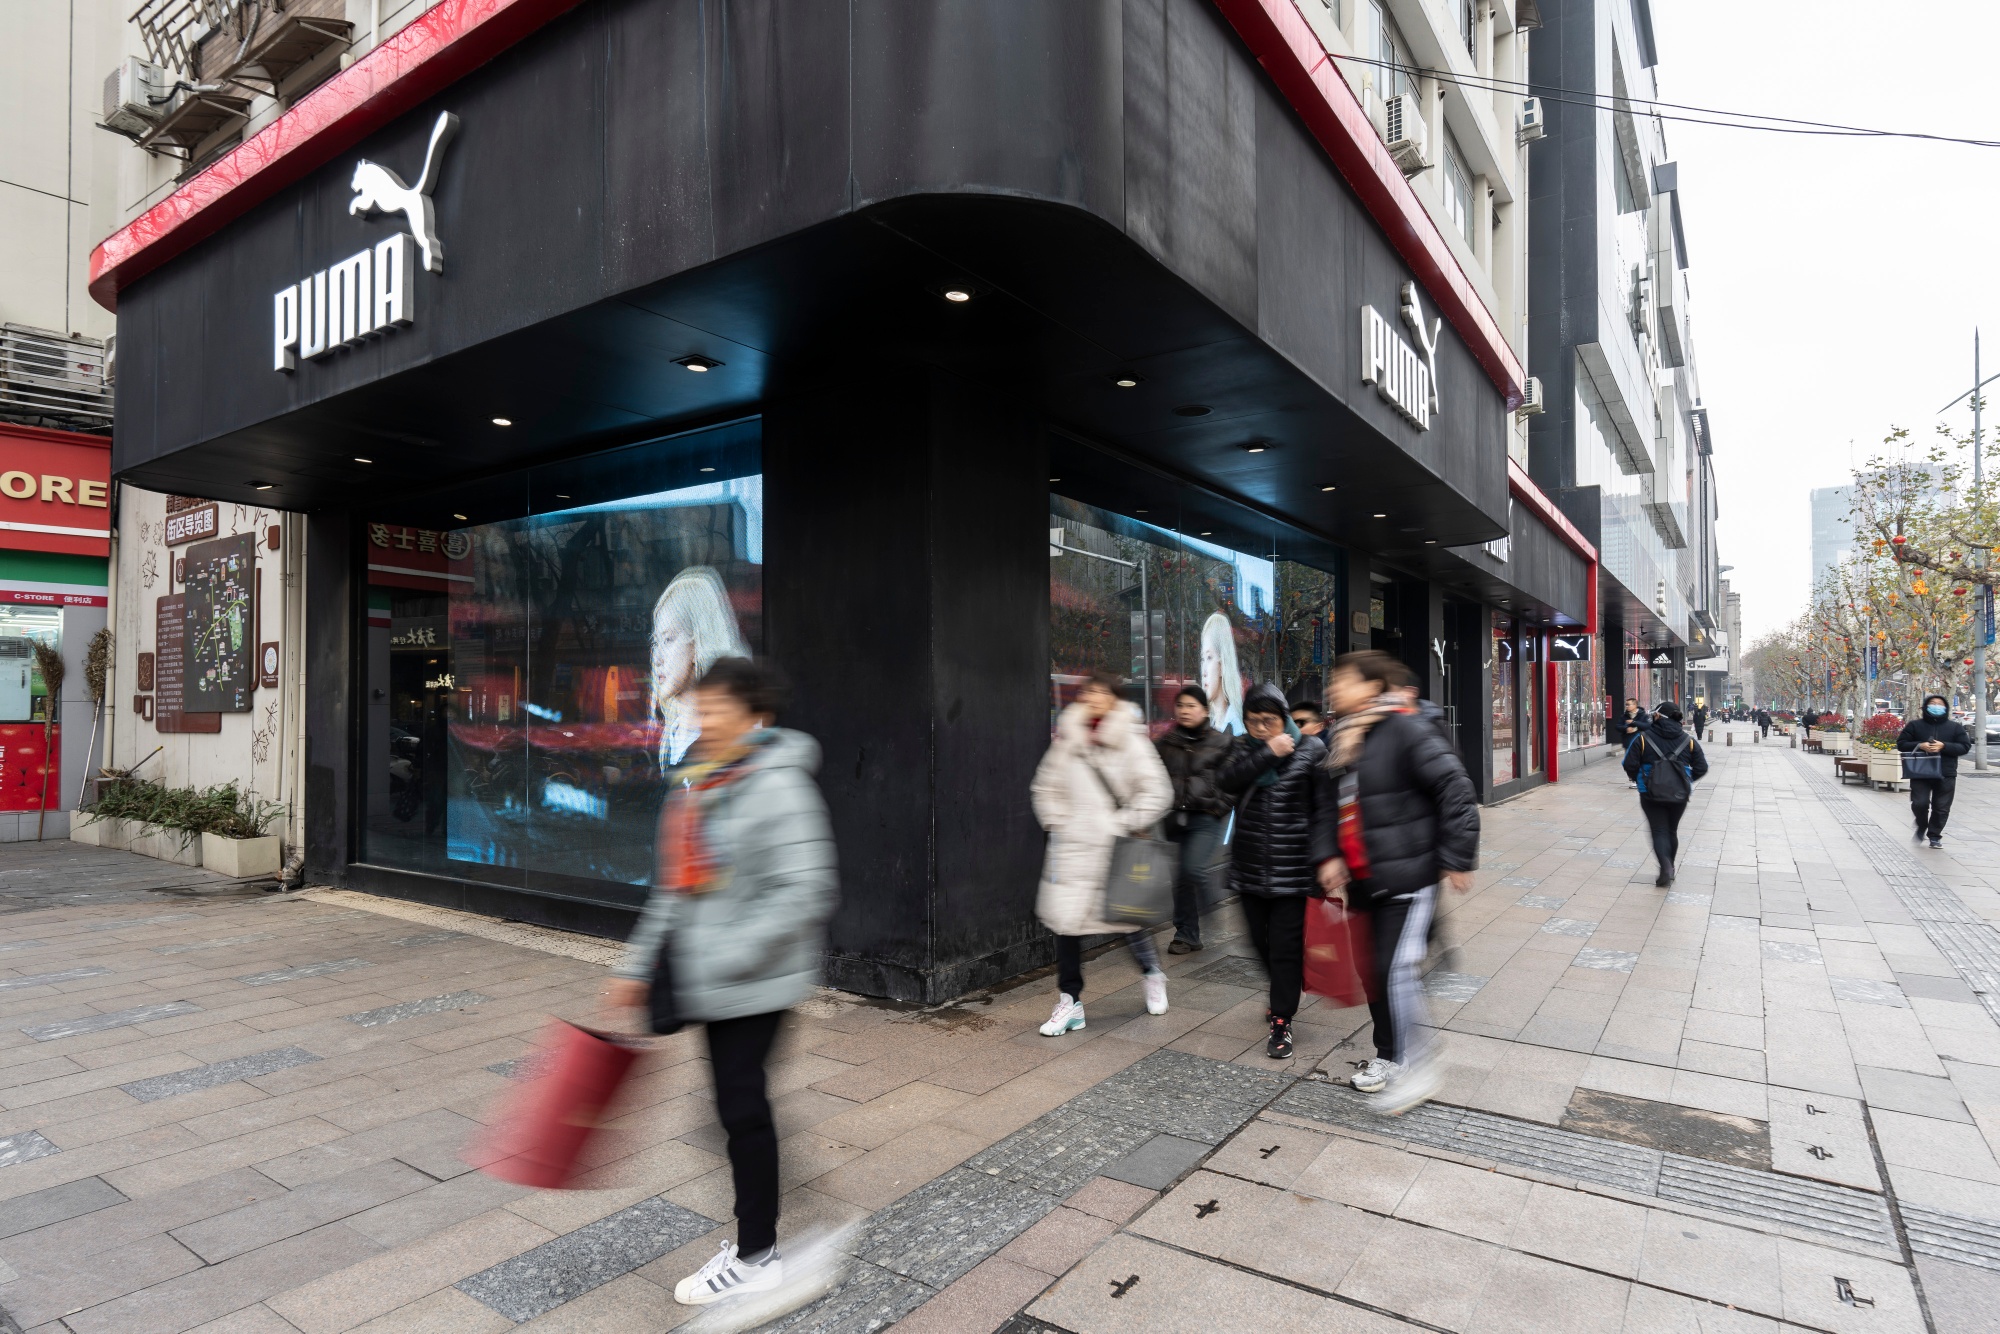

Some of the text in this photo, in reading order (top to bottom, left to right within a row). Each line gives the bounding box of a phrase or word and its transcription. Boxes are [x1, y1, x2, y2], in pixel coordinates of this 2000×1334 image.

[274, 231, 413, 373] PUMA
[1361, 304, 1429, 432] PUMA
[0, 470, 108, 508] ORE
[166, 508, 214, 541] 街区导览图
[14, 593, 55, 602] C-STORE
[63, 595, 92, 604] 便利店
